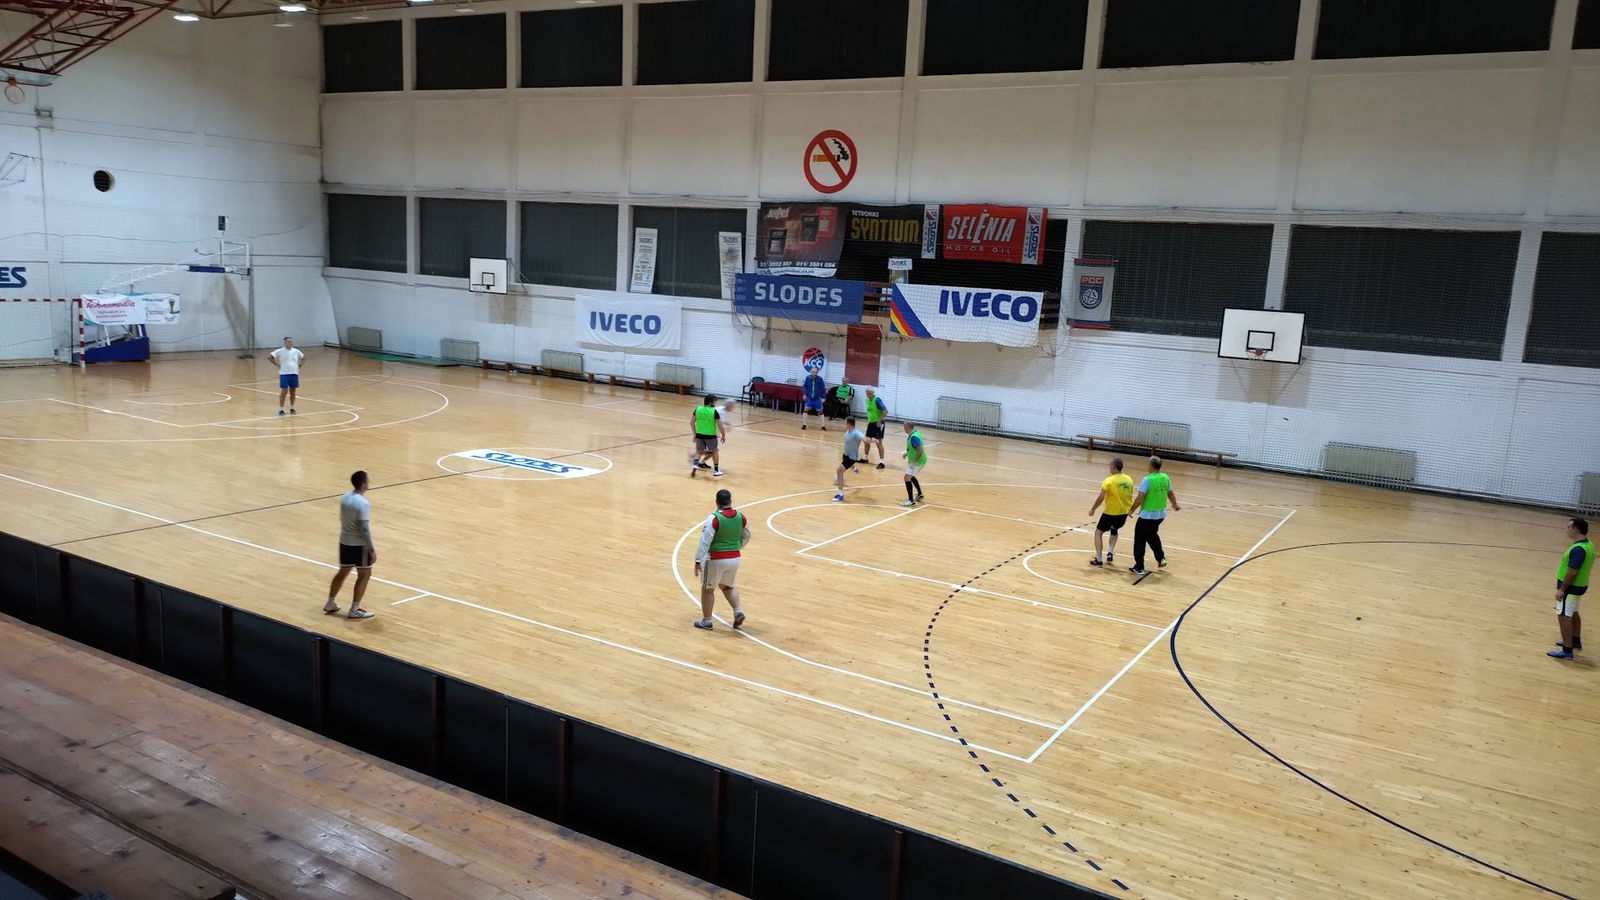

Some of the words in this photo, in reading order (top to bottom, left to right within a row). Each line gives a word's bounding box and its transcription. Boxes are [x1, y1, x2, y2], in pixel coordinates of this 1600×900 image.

[992, 246, 1012, 254] OIL
[754, 282, 843, 307] SLODES
[939, 290, 1038, 322] IVECO
[590, 311, 661, 334] IVECO
[472, 452, 583, 474] SLODES
